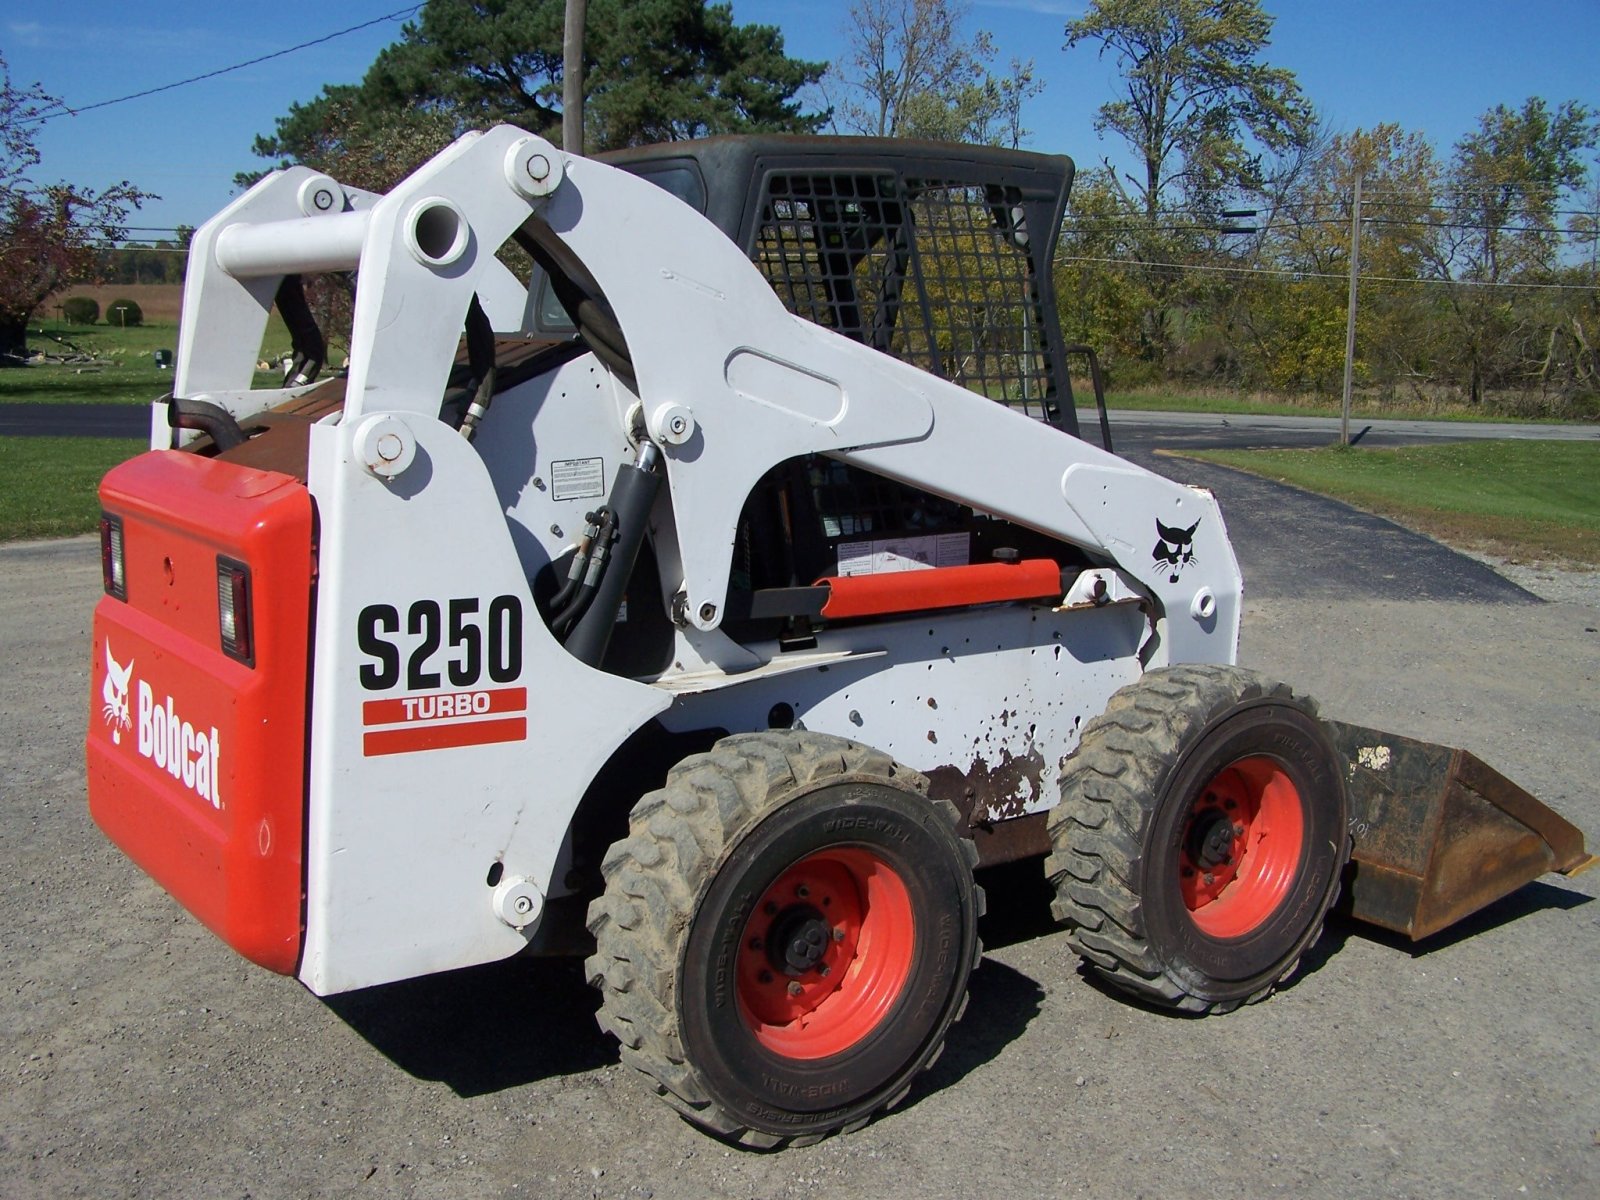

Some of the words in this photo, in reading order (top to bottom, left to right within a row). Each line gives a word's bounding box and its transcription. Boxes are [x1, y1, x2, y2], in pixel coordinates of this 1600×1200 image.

[358, 595, 522, 690] S250
[139, 679, 220, 809] Bobcat
[402, 692, 491, 720] TURBO
